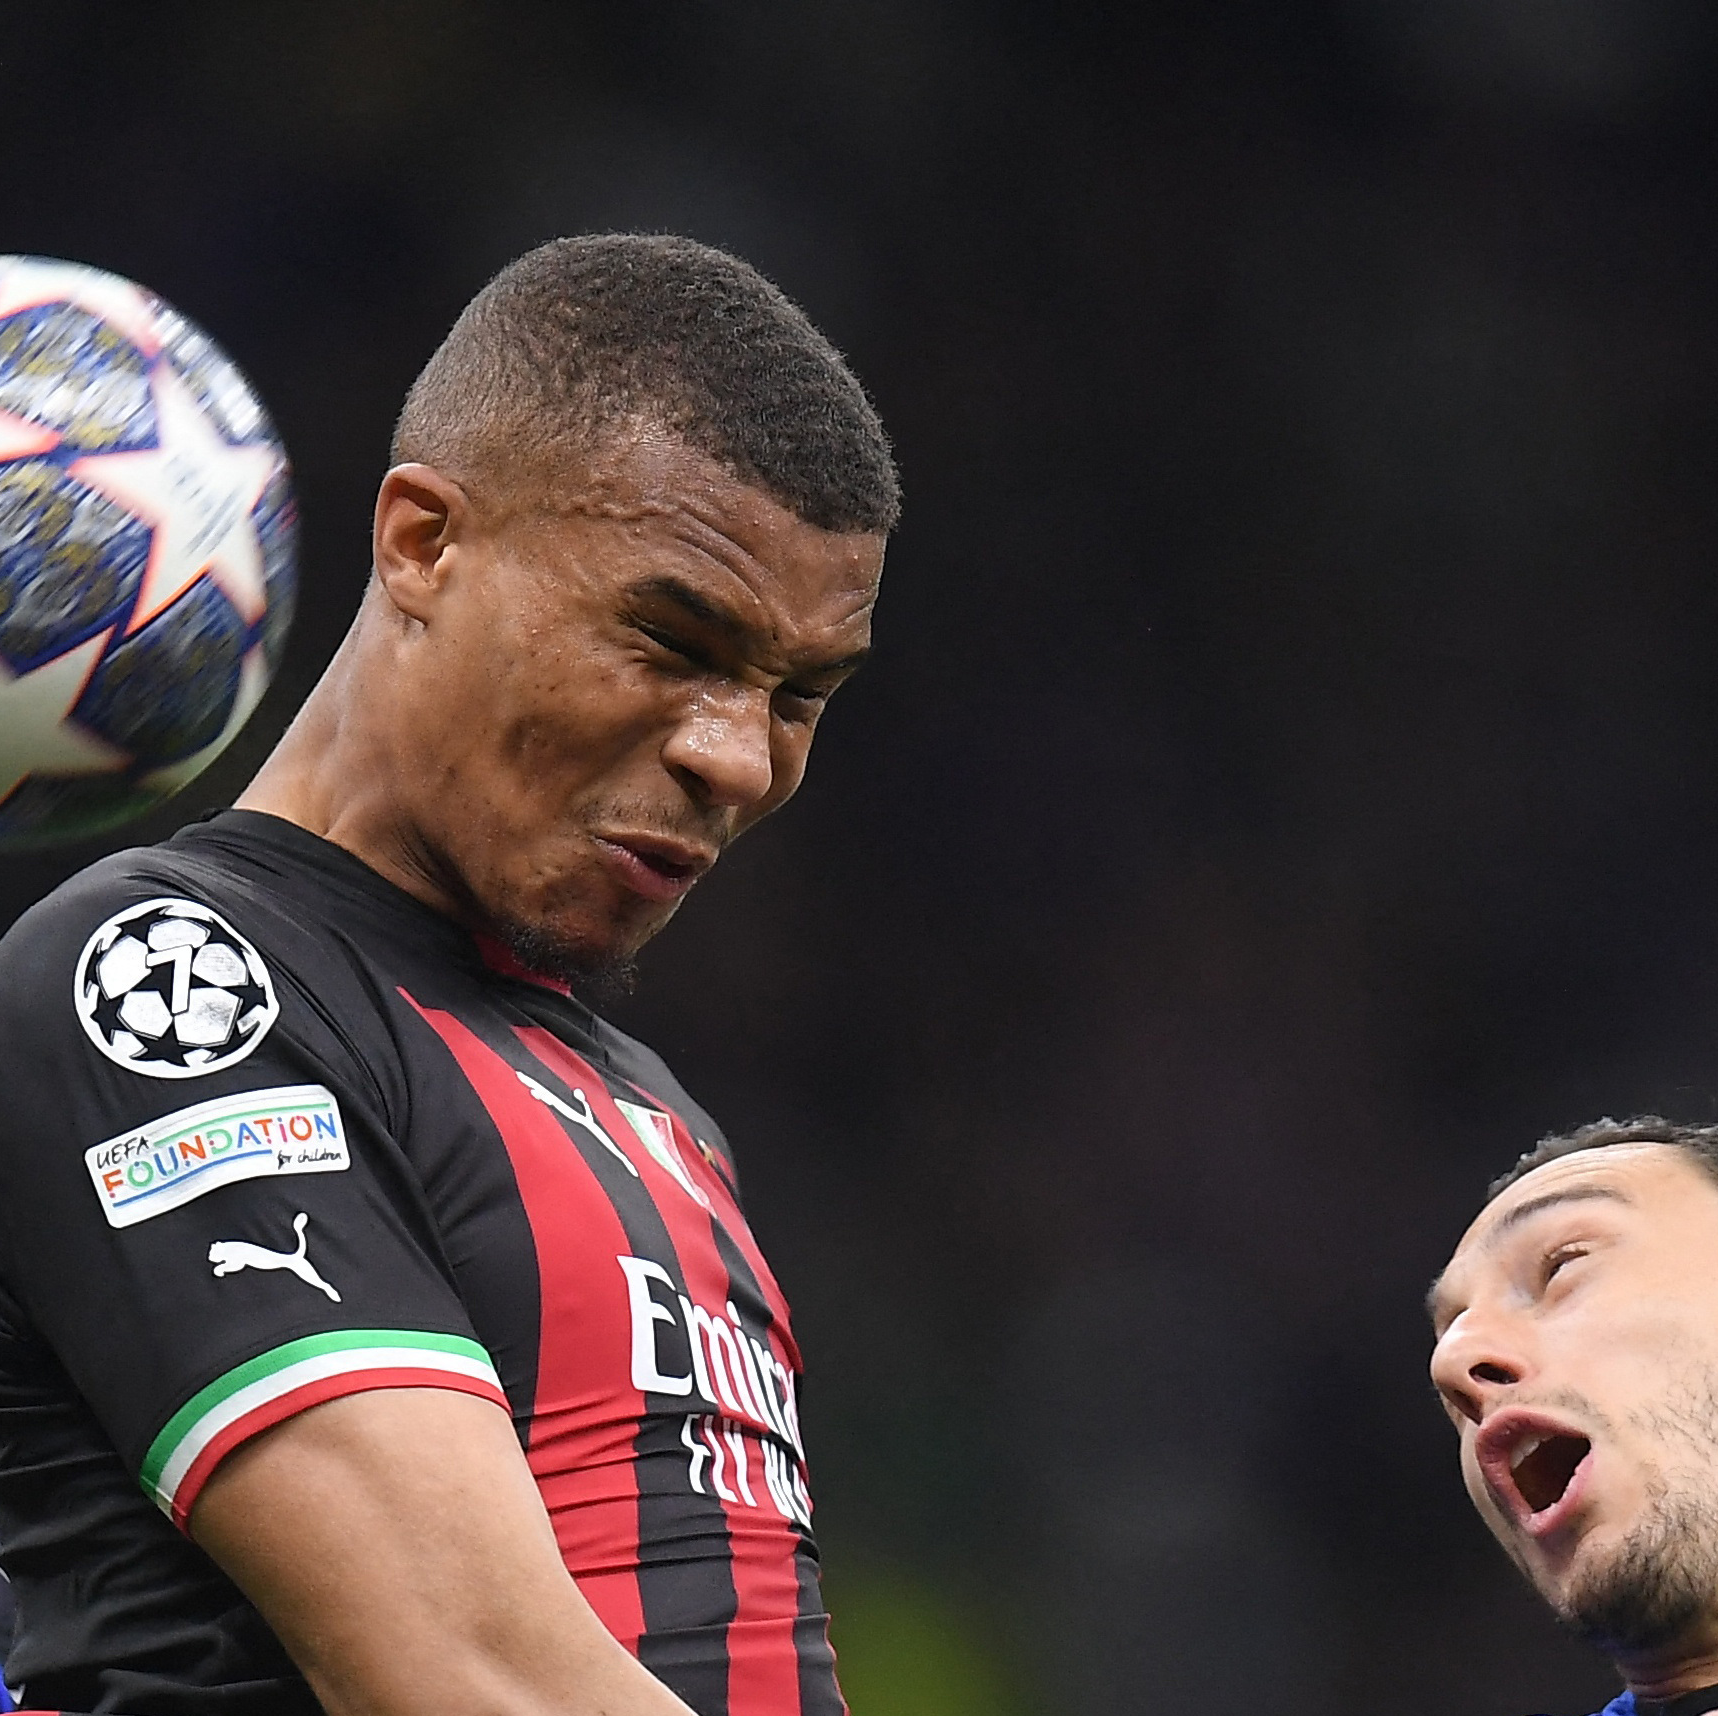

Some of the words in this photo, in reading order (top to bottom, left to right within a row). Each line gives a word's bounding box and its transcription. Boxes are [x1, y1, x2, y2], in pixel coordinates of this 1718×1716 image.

[146, 944, 193, 1015] 7
[96, 1135, 149, 1169] UEFA
[277, 1149, 293, 1171] for
[297, 1147, 343, 1164] children
